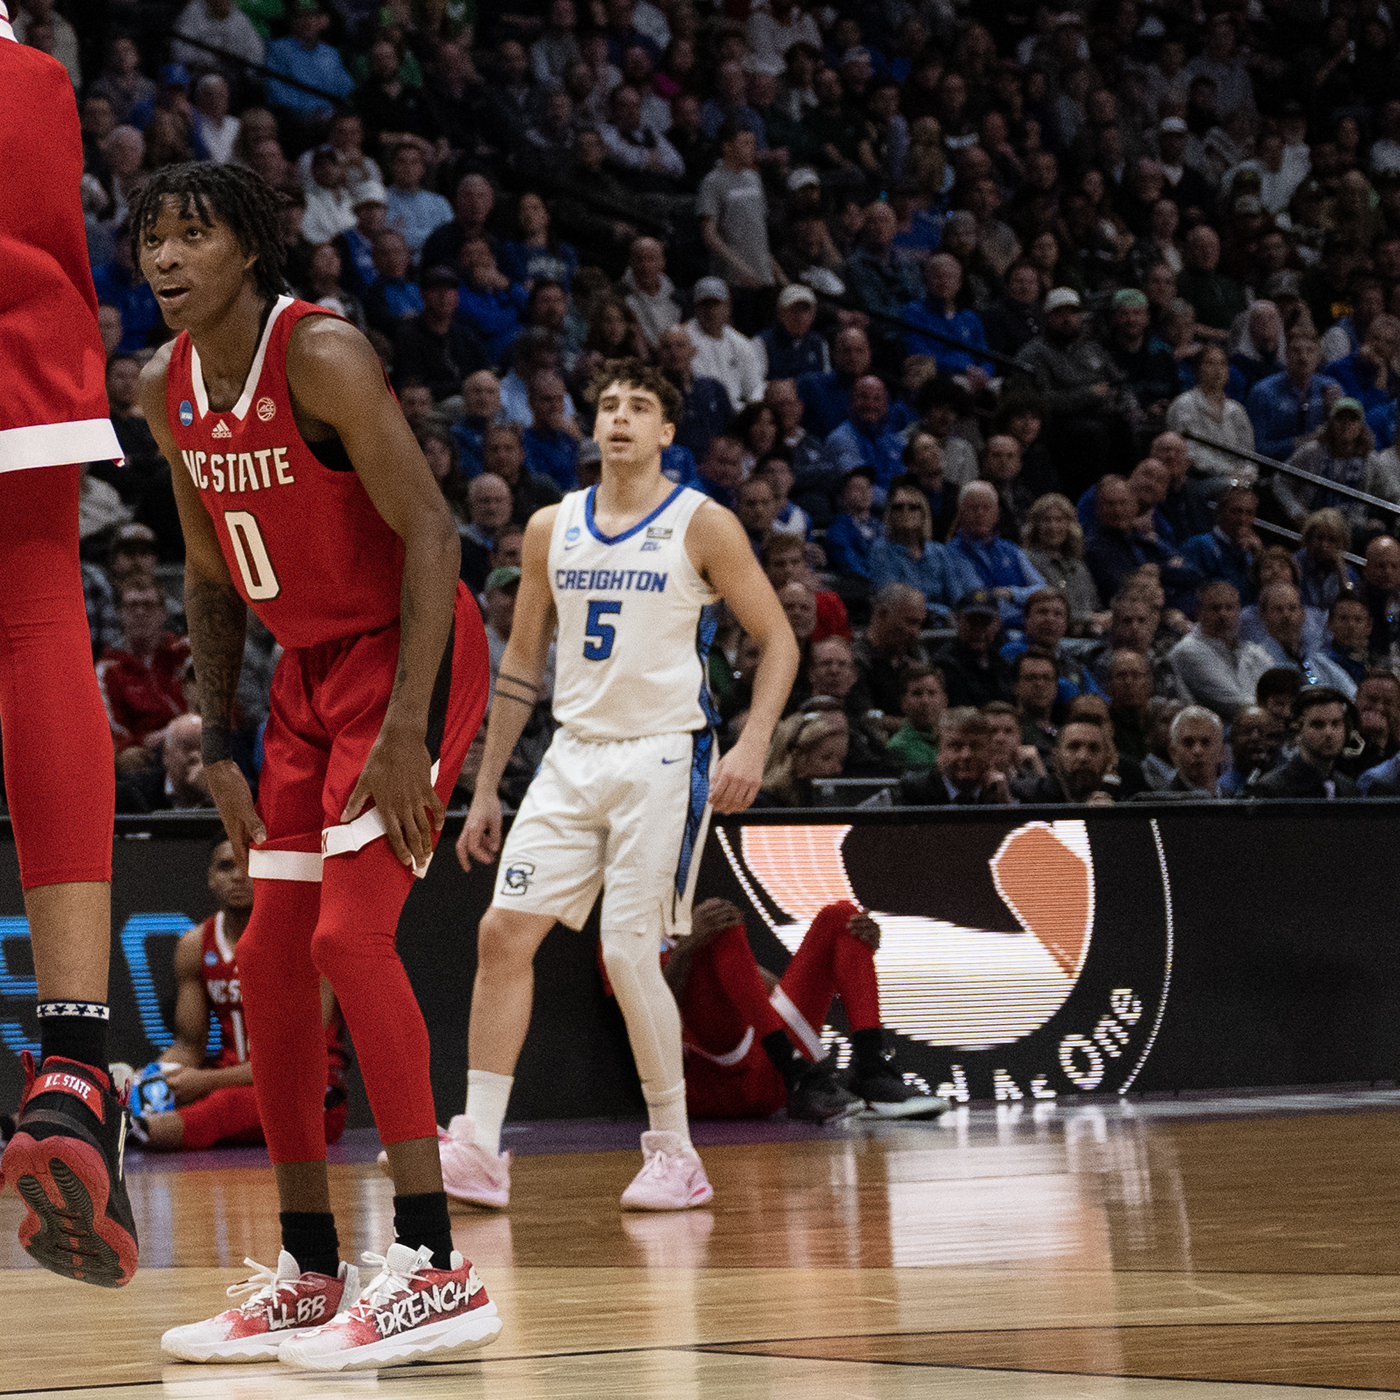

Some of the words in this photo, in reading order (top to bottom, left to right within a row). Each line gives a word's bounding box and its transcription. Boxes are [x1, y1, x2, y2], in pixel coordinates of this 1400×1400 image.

[181, 449, 209, 490] NC
[209, 446, 296, 493] STATE
[223, 509, 283, 603] 0
[555, 568, 669, 593] CREIGHTON
[583, 599, 623, 662] 5
[1058, 987, 1143, 1091] One
[62, 1074, 93, 1101] STATE
[266, 1294, 328, 1331] LLBB
